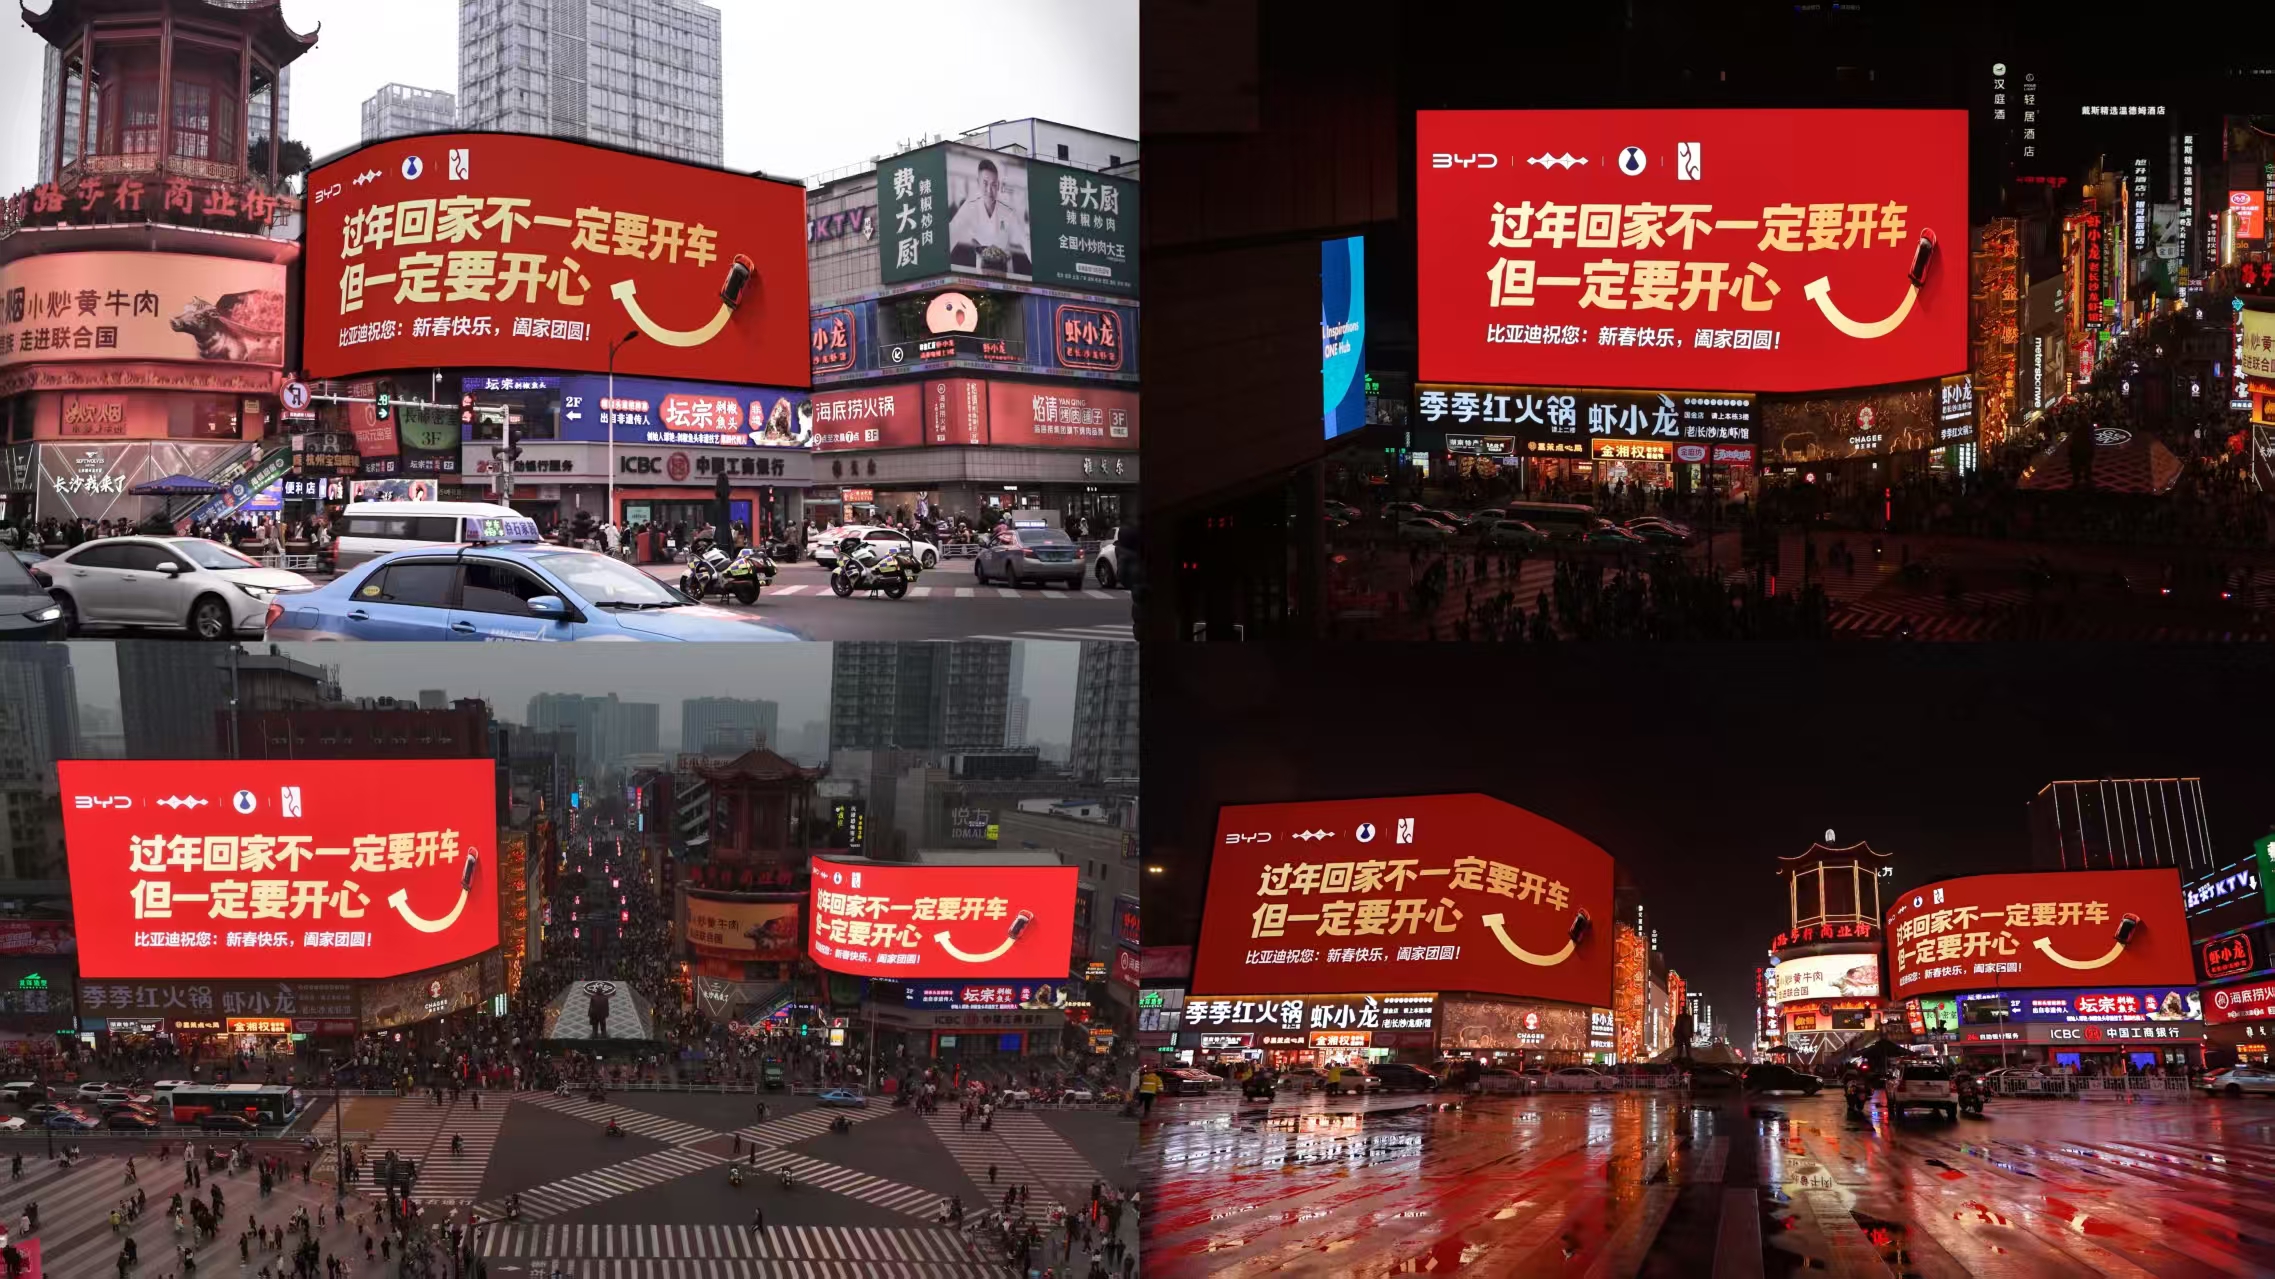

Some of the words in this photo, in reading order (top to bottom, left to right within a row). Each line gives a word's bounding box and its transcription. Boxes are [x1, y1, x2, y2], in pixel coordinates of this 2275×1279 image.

[1993, 78, 2006, 120] 汉庭酒
[2081, 105, 2166, 116] 戴斯精选温德姆酒店
[2023, 93, 2036, 157] 轻居酒店
[1432, 153, 1498, 168] BYD
[315, 183, 342, 203] BYD
[1058, 174, 1120, 216] 费大厨
[893, 167, 920, 270] 费大厨
[918, 178, 934, 247] 辣椒炒肉
[1066, 209, 1116, 233] 辣椒炒肉
[340, 194, 718, 268] 过年回家不一定要开车
[1487, 200, 1909, 252] 过年回家不一定要开车
[1058, 234, 1127, 259] 全国小炒肉大王
[339, 250, 592, 315] 但一定要开心
[1486, 256, 1782, 312] 但一定要开心
[1064, 312, 1116, 347] 虾小龙
[1326, 320, 1360, 341] Inspirations
[1324, 343, 1338, 359] ONE
[1338, 342, 1351, 355] Hub
[485, 378, 513, 391] 坛宗
[1941, 375, 1973, 405] 虾小龙
[565, 396, 583, 408] 2F
[665, 398, 713, 429] 坛宗
[715, 400, 739, 415] 剁椒
[815, 395, 895, 423] 海底捞火锅
[1032, 394, 1059, 423] 焰请
[1419, 390, 1577, 426] 季季红火锅
[1588, 392, 1680, 437] 虾小龙
[1059, 407, 1103, 425] 烤肉铺子
[1111, 412, 1125, 426] 3F
[421, 431, 442, 446] 3F
[865, 429, 879, 442] 3F
[1849, 433, 1883, 444] CHAGEE
[1600, 443, 1646, 459] 金湘权
[620, 455, 663, 474] ICBC
[696, 455, 785, 476] 中国工商银行
[52, 474, 127, 494] 长沙我来了
[74, 795, 133, 809] BYD
[128, 827, 460, 873] 过年回家不一定要开车
[1225, 832, 1272, 844] BYD
[1256, 855, 1570, 912] 过年回家不一定要开车
[129, 879, 371, 920] 但一定要开心
[816, 887, 1009, 921] 过年回家不一定要开车
[1251, 897, 1464, 939] 但一定要开心
[1896, 900, 2110, 948] 过年回家不一定要开车
[1897, 930, 2020, 973] 但一定要开心
[2208, 939, 2246, 965] 虾小龙
[82, 985, 214, 1010] 季季红火锅
[222, 982, 297, 1014] 虾小龙
[963, 987, 995, 1003] 坛宗
[2078, 995, 2116, 1014] 坛宗
[1185, 999, 1304, 1026] 季季红火锅
[1310, 995, 1380, 1029] 虾小龙
[1591, 1010, 1614, 1027] 虾小龙
[1925, 1011, 1958, 1020] 長密室
[233, 1020, 270, 1033] 金湘权
[2050, 1028, 2081, 1039] ICBC
[2106, 1026, 2180, 1039] 中国工商银行
[1315, 1035, 1350, 1047] 金湘权
